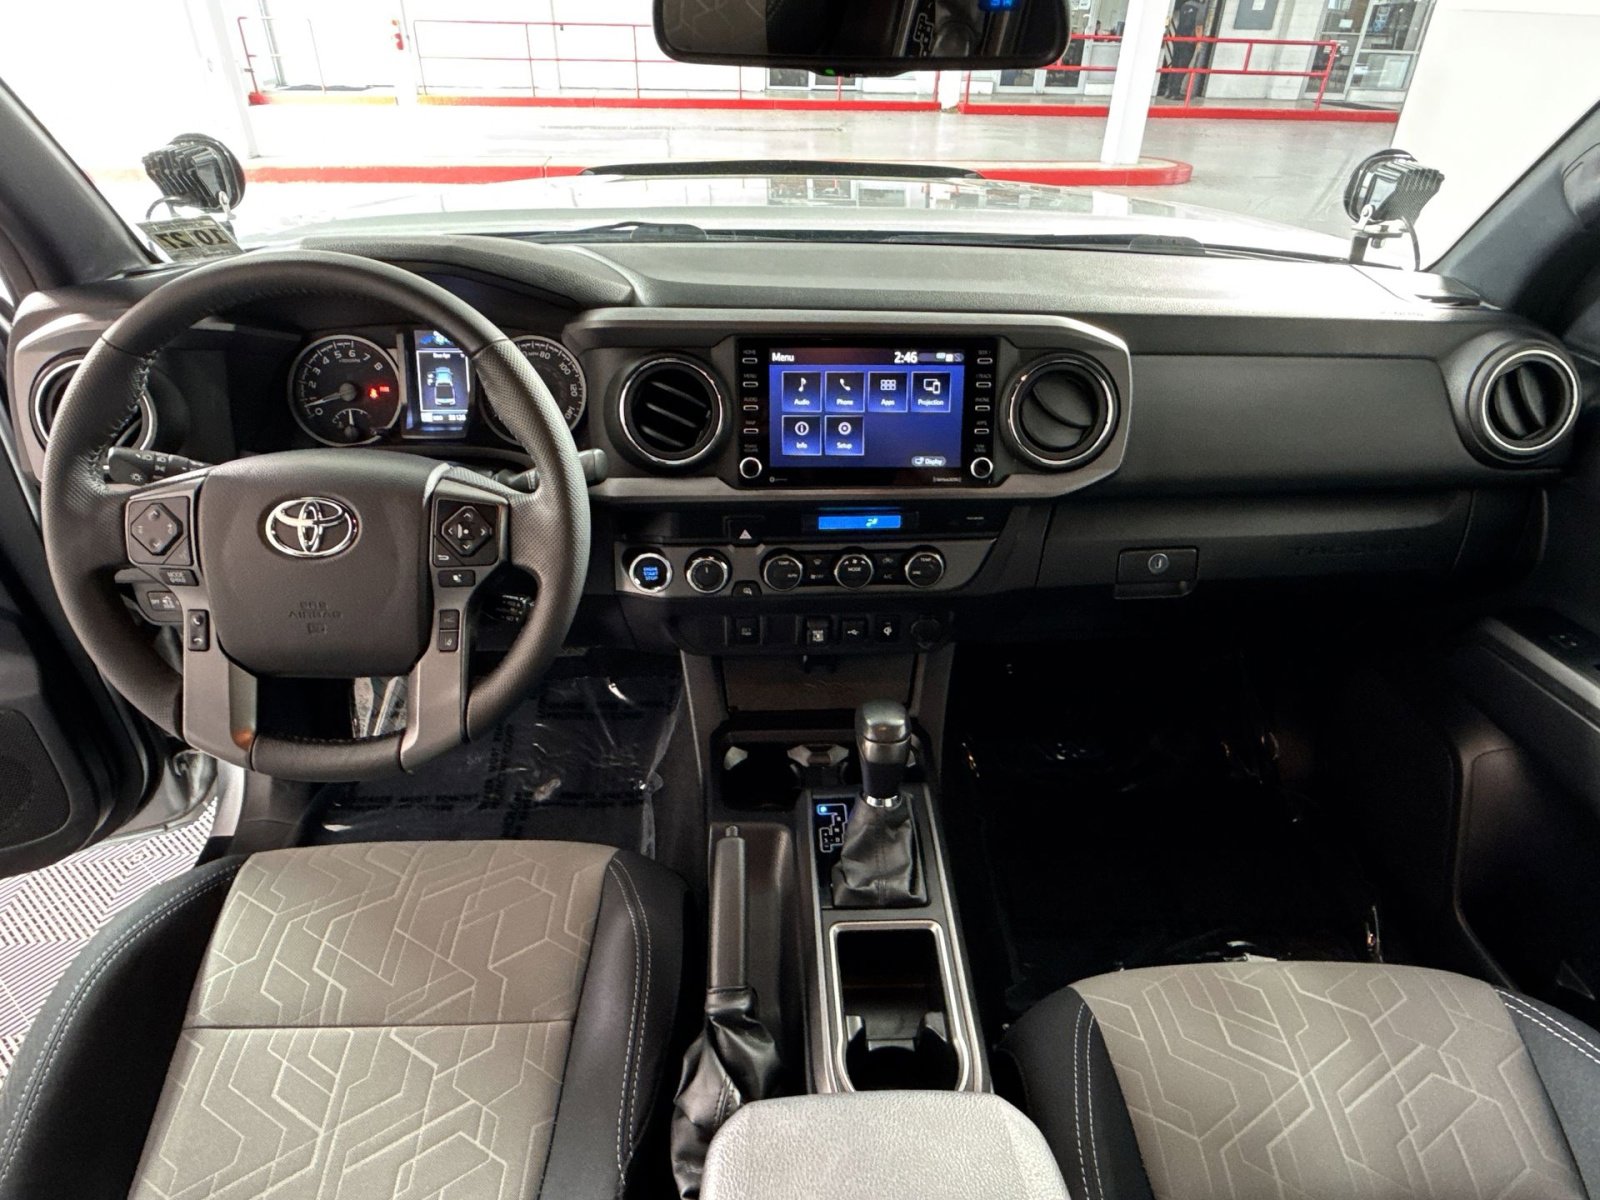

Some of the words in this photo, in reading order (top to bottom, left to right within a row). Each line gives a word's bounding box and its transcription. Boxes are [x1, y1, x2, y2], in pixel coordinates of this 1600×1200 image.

[333, 350, 342, 359] 5
[539, 351, 551, 360] 80
[771, 352, 795, 362] Menu
[894, 351, 917, 363] 2:46
[322, 356, 330, 365] 4
[373, 361, 383, 371] 8
[558, 361, 571, 375] 100
[569, 383, 578, 397] 120
[793, 398, 810, 406] Audio
[836, 398, 854, 406] Phone
[880, 398, 895, 407] Apps
[917, 398, 944, 407] Projection
[836, 442, 853, 450] Setup
[925, 458, 943, 466] Display
